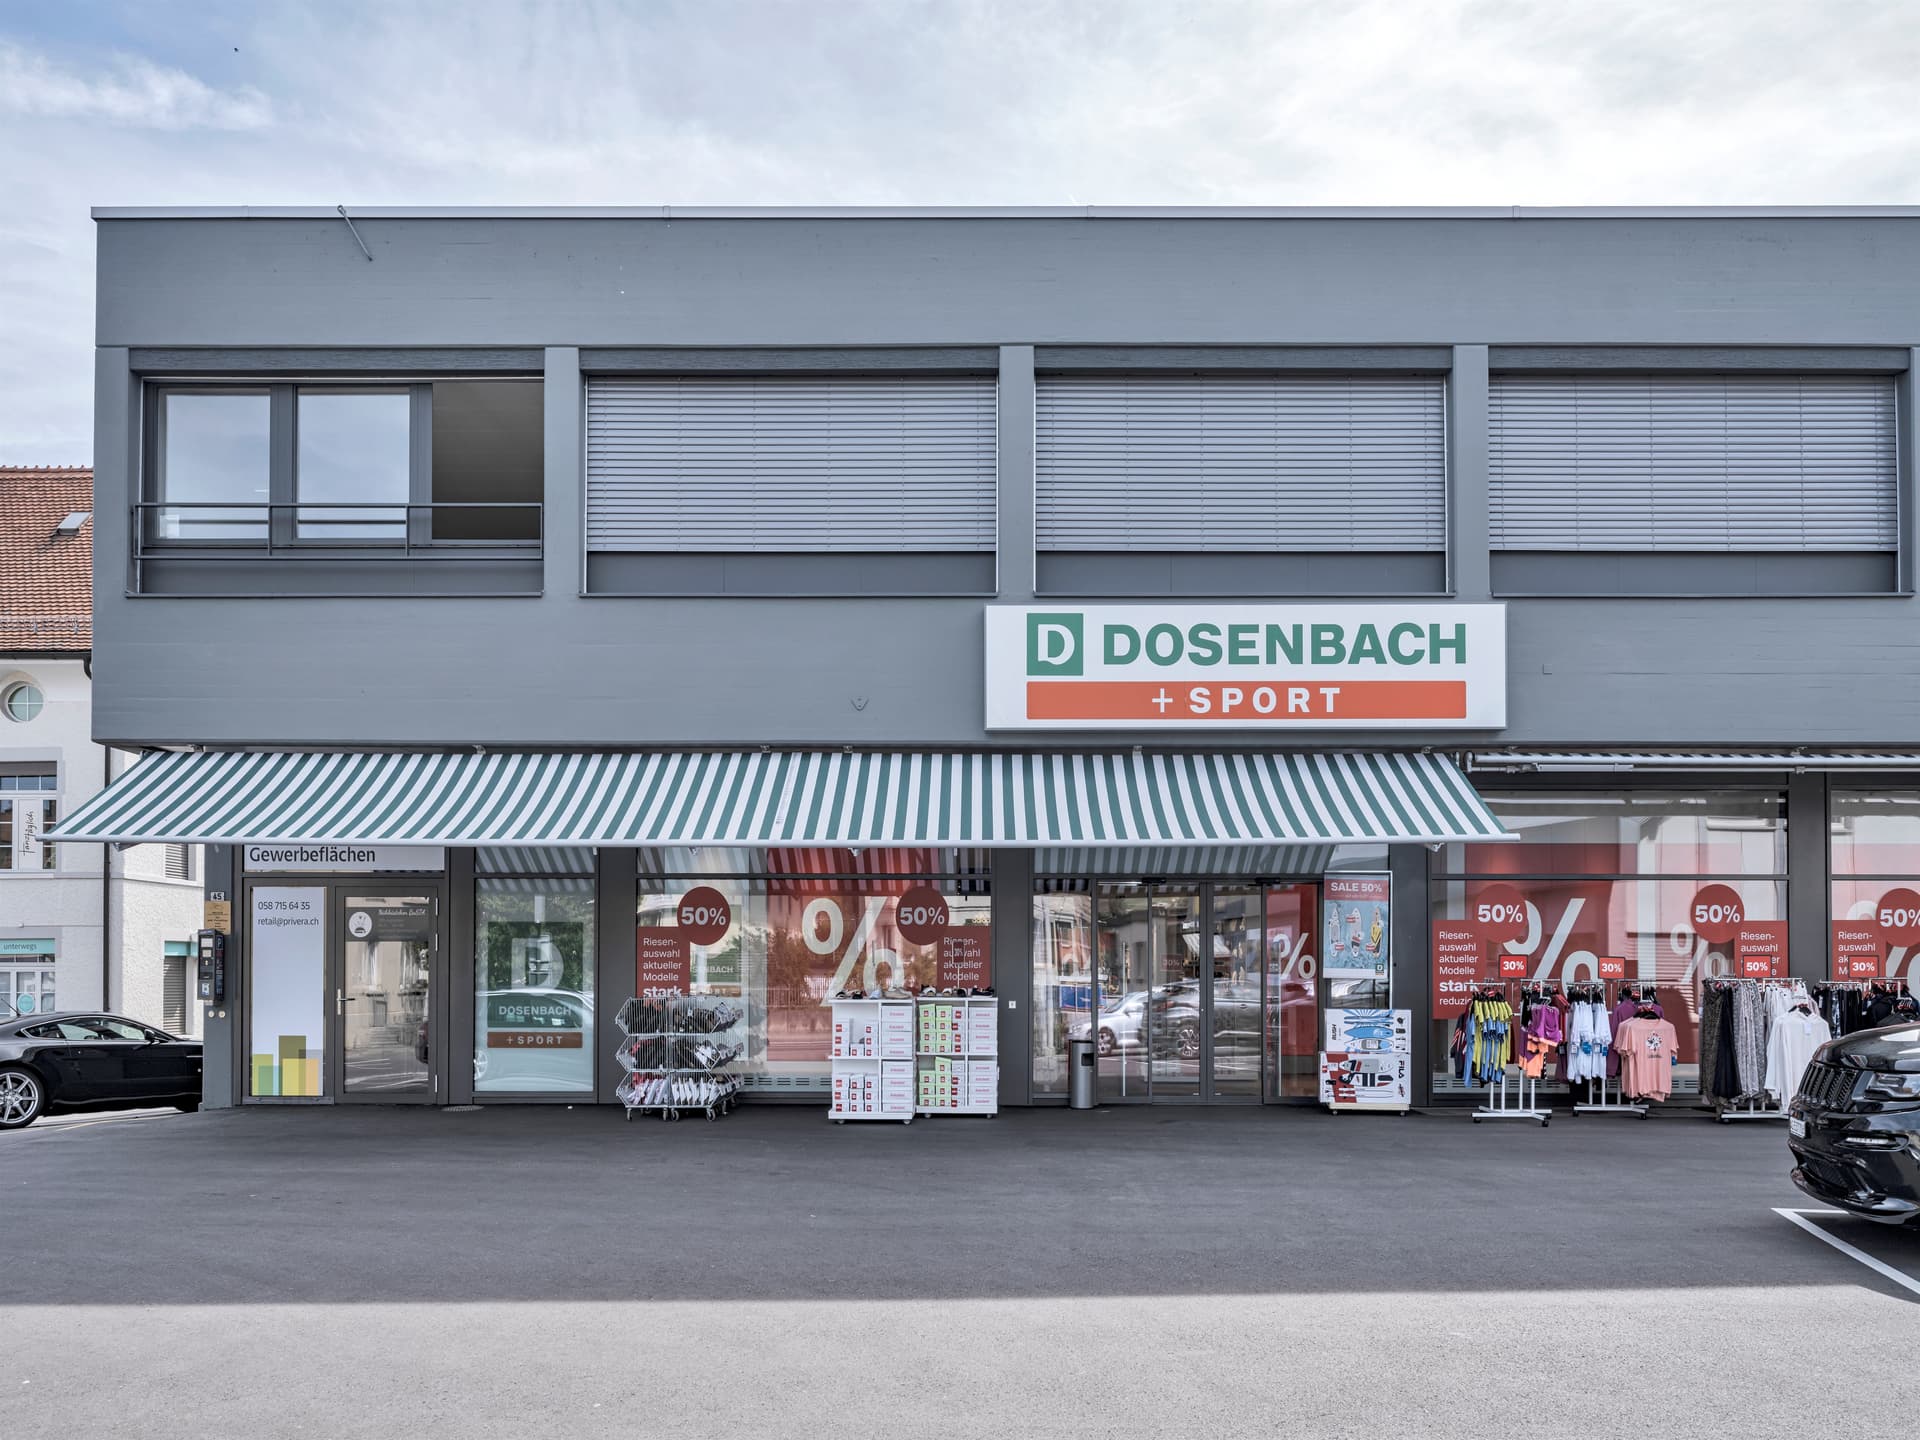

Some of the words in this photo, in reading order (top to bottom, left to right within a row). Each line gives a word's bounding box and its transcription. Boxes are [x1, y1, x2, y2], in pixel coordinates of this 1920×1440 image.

[1103, 622, 1467, 666] DOSENBACH
[1189, 687, 1341, 714] SPORT
[249, 846, 376, 863] Gewerbeflächen
[1330, 882, 1359, 892] SALE
[1361, 883, 1383, 893] 50%
[257, 901, 273, 910] 058
[275, 901, 288, 910] 715
[289, 901, 299, 910] 64
[300, 901, 311, 910] 35
[681, 906, 726, 925] 50%
[900, 906, 945, 925] 50%
[1477, 904, 1523, 923] 50%
[1695, 904, 1741, 923] 50%
[257, 917, 320, 927] retail@privera.ch
[1439, 931, 1473, 940] Riesen-
[1740, 932, 1775, 941] Riesen-
[1838, 931, 1873, 940] Riesen-
[643, 937, 677, 946] Riesen-
[3, 943, 37, 951] unterwegs
[1439, 943, 1476, 952] auswahl
[1740, 944, 1778, 953] auswahl
[1838, 943, 1876, 952] auswahl
[643, 949, 680, 958] auswahl
[1439, 954, 1478, 963] aktueller
[643, 961, 682, 970] aktueller
[1503, 961, 1524, 971] 30%
[1601, 963, 1622, 973] 30%
[1746, 962, 1768, 972] 50%
[1852, 962, 1875, 972] 30%
[1439, 966, 1475, 975] Modelle
[643, 973, 679, 981] Modelle
[943, 972, 980, 981] Modelle
[1439, 979, 1479, 992] stark
[643, 986, 682, 998] stark
[498, 1006, 572, 1016] DOSENBACH
[517, 1036, 563, 1045] SPORT
